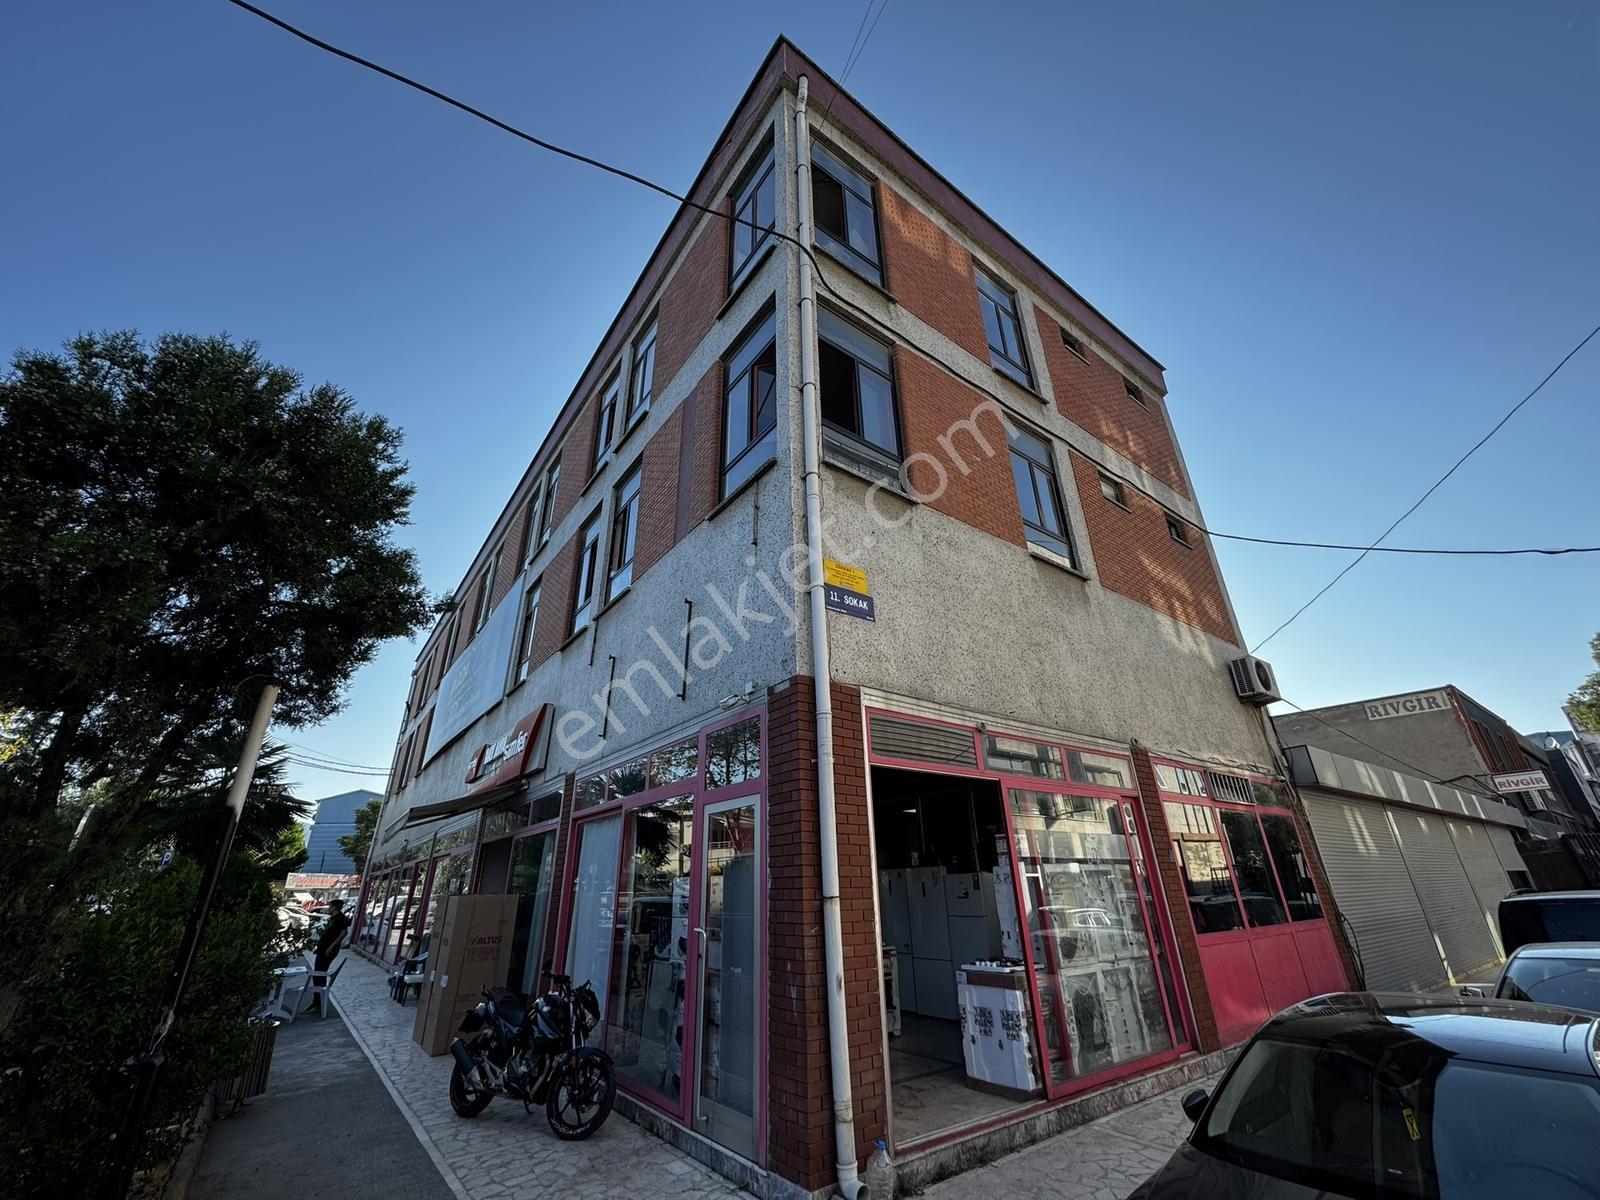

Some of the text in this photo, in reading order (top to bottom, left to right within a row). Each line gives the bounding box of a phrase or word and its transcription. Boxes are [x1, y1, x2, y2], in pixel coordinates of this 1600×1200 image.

[829, 591, 841, 602] 11.
[843, 595, 868, 610] SOKAK
[477, 935, 503, 945] ALTUS
